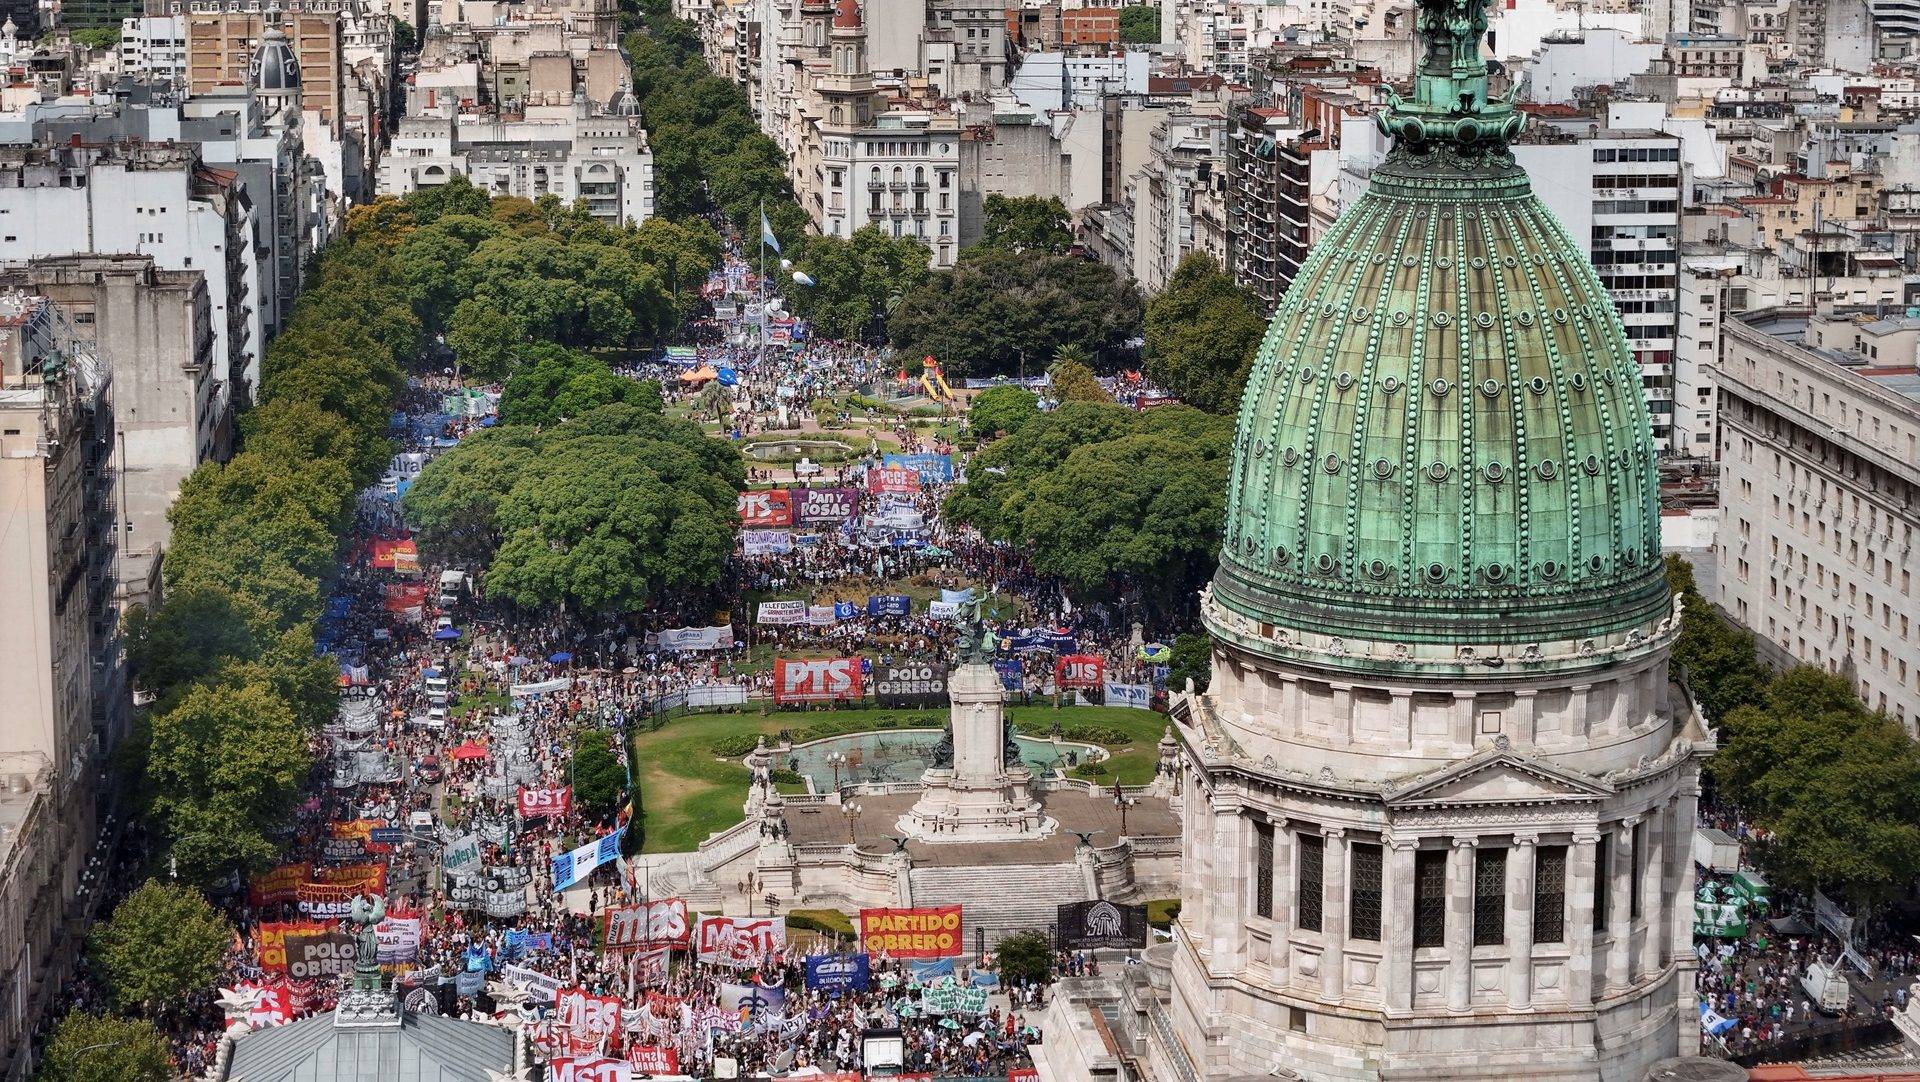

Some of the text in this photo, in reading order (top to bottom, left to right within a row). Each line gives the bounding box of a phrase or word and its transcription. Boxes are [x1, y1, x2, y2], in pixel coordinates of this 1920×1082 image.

[881, 470, 907, 485] PCCE
[801, 502, 851, 517] ROSAS
[785, 660, 852, 693] PTS
[889, 668, 933, 681] POLO
[1065, 662, 1098, 680] JIS
[878, 680, 944, 695] OBRERO
[523, 788, 567, 806] OST
[328, 840, 359, 848] POLO
[456, 875, 499, 891] POLO
[609, 913, 620, 941] nuevo
[866, 913, 960, 932] PARTIDO
[1087, 917, 1122, 936] SUTNA
[706, 921, 774, 959] MST
[865, 933, 954, 952] OBRERO
[304, 942, 355, 960] POLO
[291, 959, 355, 977] OBRER
